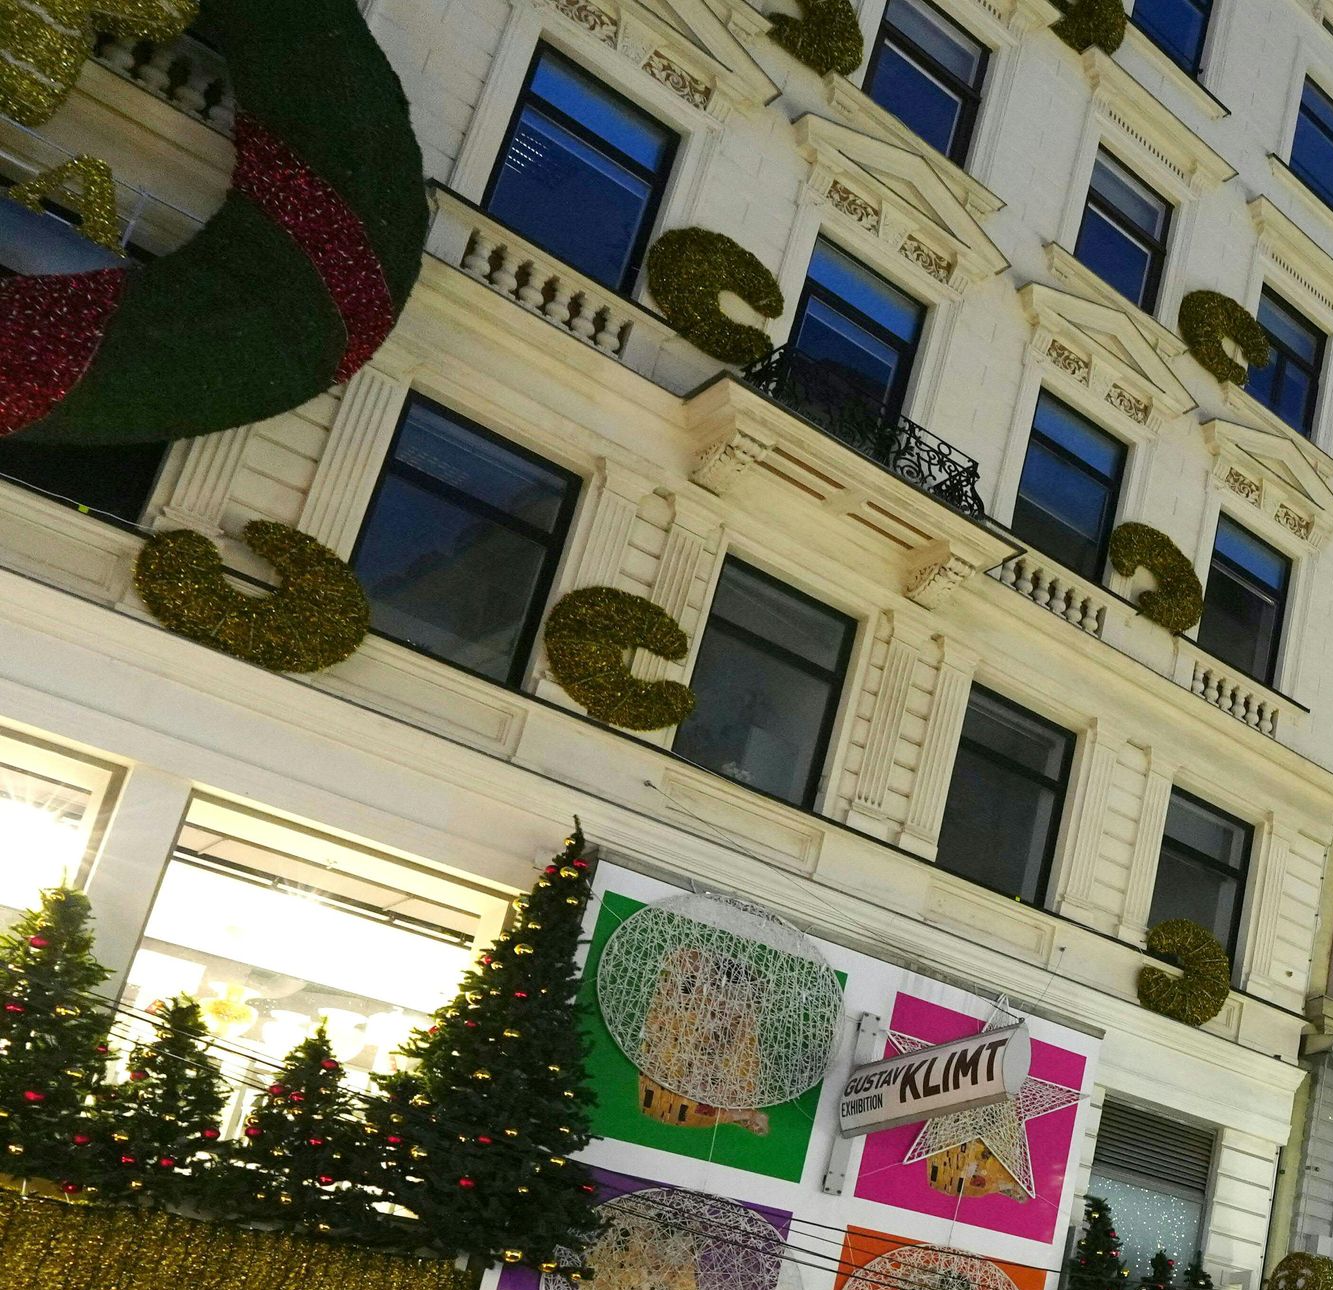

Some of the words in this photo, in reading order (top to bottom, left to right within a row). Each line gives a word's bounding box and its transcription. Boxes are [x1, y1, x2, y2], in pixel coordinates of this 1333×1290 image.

[844, 1065, 906, 1097] GUSTAV
[900, 1038, 1009, 1103] KLIMT
[841, 1094, 883, 1118] EXHIBITION
